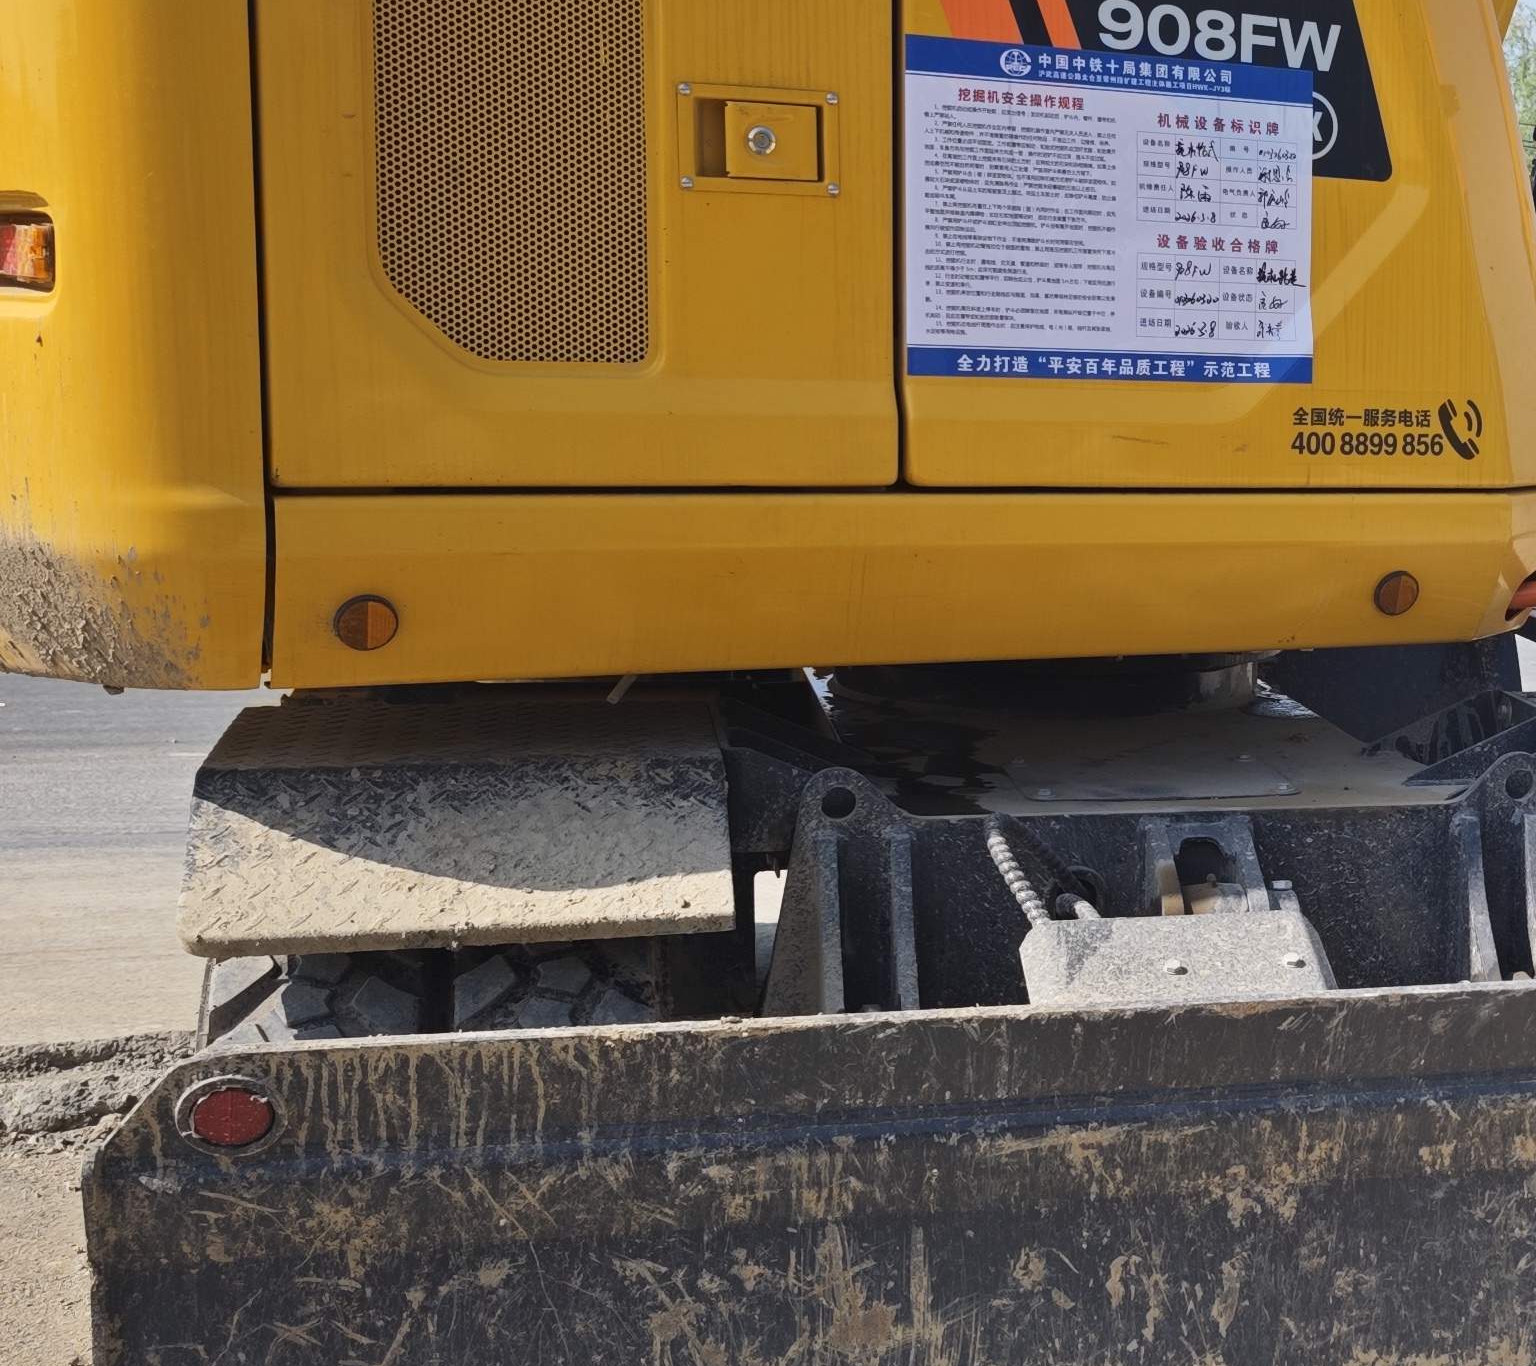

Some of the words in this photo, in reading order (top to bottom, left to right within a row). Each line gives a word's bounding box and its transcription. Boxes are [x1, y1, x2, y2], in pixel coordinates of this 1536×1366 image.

[1038, 53, 1232, 85] 中国中铁十局集团有限公司
[958, 87, 1085, 110] 挖掘机安全操作规程
[1157, 113, 1279, 136] 机械设备标识牌
[1157, 234, 1279, 255] 设备验收合格牌
[1293, 407, 1431, 427] 全国统一服务电话
[1291, 432, 1335, 455] 400
[1340, 432, 1397, 456] 8899
[1402, 433, 1444, 456] 856
